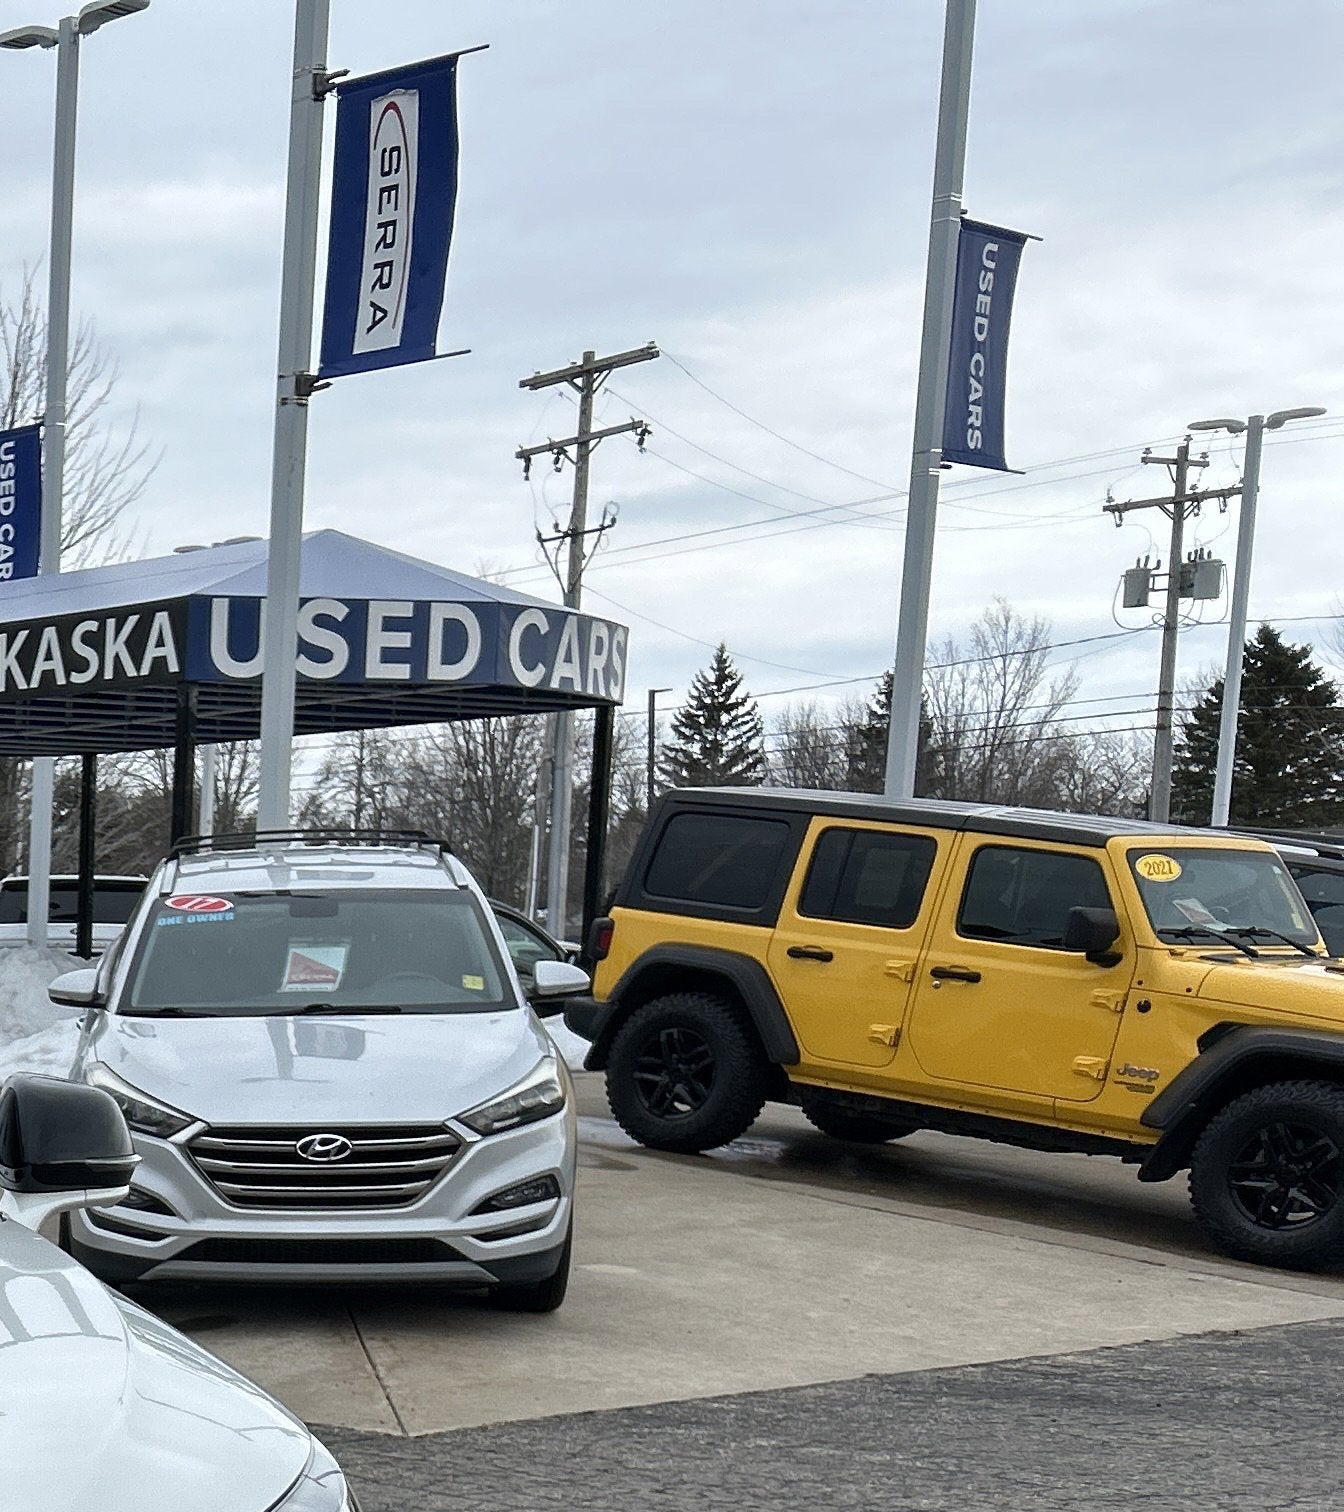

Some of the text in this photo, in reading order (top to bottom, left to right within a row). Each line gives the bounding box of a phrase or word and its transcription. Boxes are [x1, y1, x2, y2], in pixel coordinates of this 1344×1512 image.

[366, 145, 402, 335] SERRA
[966, 241, 1000, 451] USED CARS
[210, 597, 626, 700] USED CARS
[1143, 859, 1174, 876] 2021
[157, 911, 235, 927] ONE OWNER
[1116, 1062, 1160, 1082] Jeep
